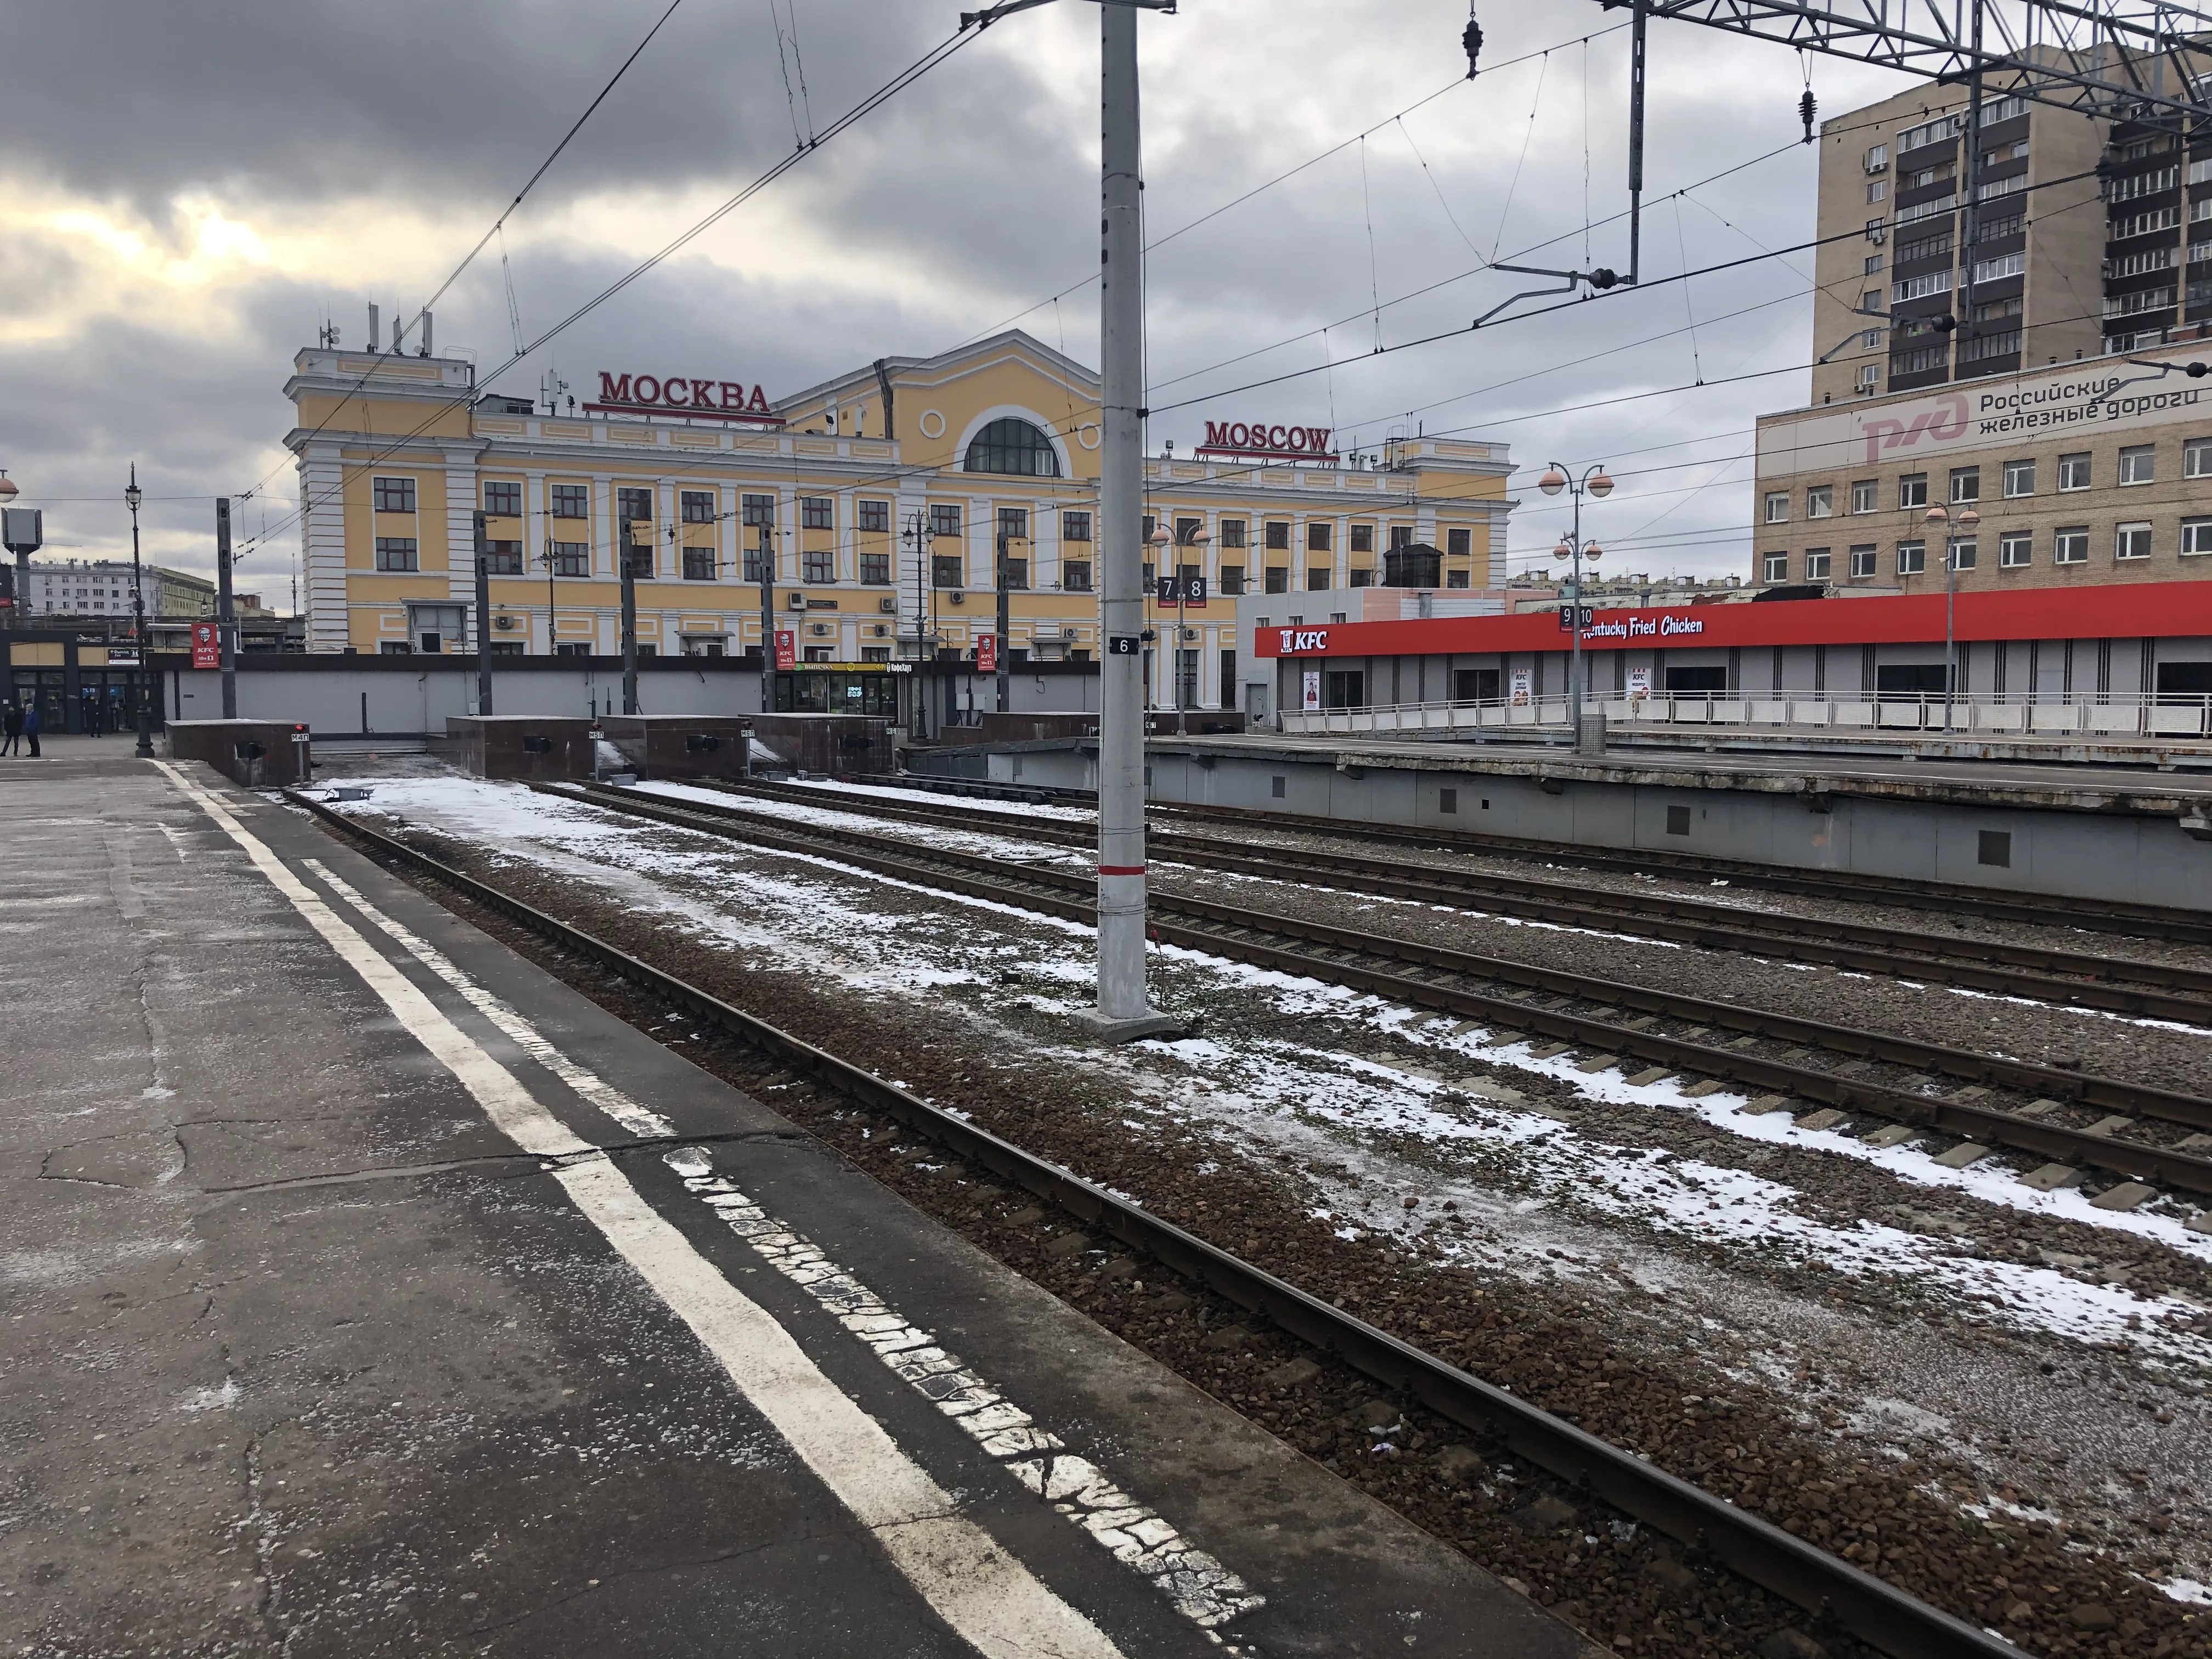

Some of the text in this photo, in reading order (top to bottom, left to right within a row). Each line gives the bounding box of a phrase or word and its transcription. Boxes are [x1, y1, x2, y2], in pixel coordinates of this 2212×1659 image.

[598, 371, 770, 412] МОСКВА
[1981, 377, 2120, 411] Российские
[1979, 390, 2199, 435] железные дороги
[1204, 420, 1331, 452] MOSCOW
[1164, 580, 1172, 595] 7
[1192, 581, 1201, 596] 8
[1564, 608, 1571, 622] 9
[1581, 609, 1592, 623] 10
[1629, 617, 1656, 637] Fried
[1661, 615, 1702, 635] Chicken
[1120, 639, 1128, 652] 6
[1294, 631, 1327, 650] KFC
[891, 663, 912, 673] КофеХауз
